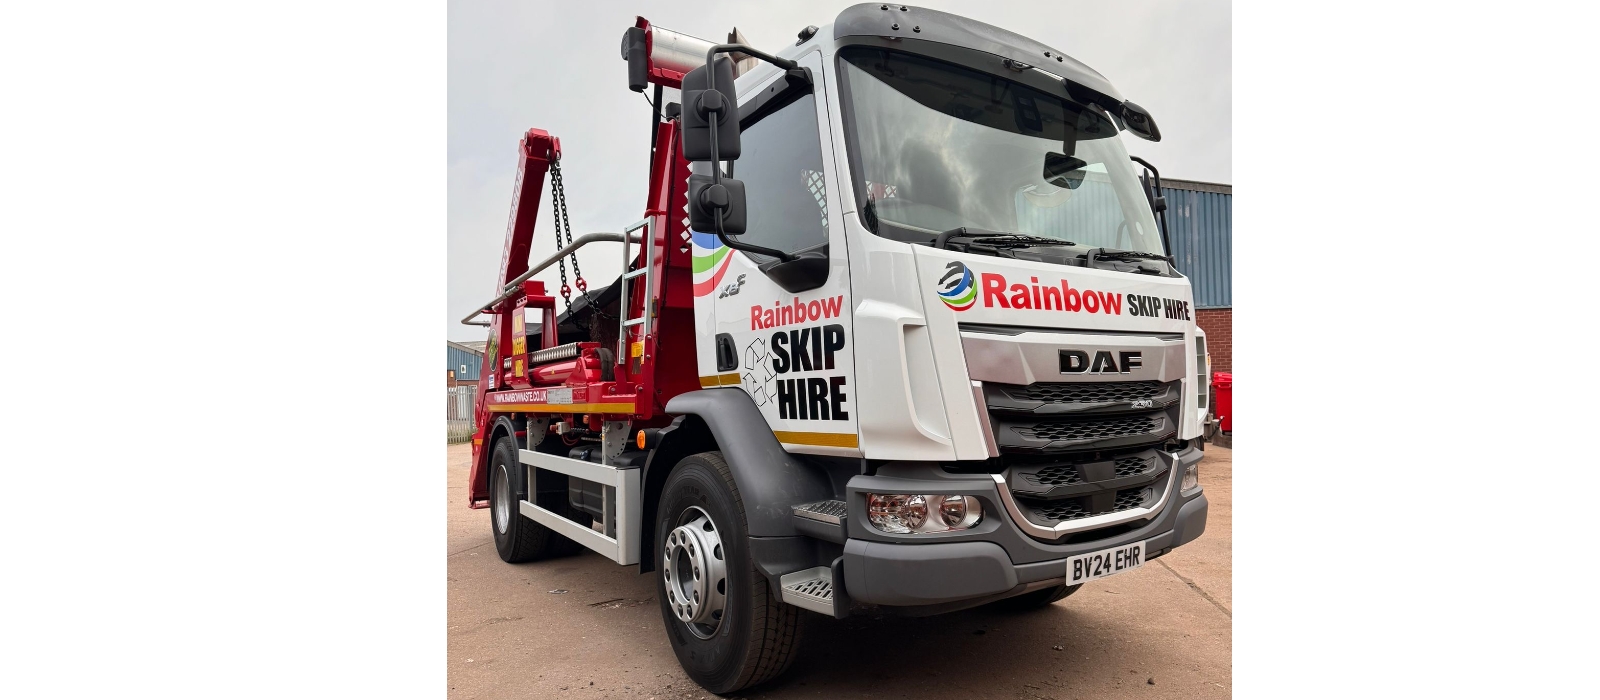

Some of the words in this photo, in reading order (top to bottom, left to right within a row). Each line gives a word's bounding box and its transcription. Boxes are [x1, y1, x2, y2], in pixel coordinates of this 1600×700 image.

[750, 295, 843, 331] Rainbow
[981, 272, 1122, 315] Rainbow
[1127, 293, 1162, 318] SKIP
[1163, 297, 1191, 321] HIRE
[771, 323, 846, 374] SKIP
[1058, 348, 1143, 376] DAF
[777, 376, 849, 421] HIRE
[1073, 552, 1112, 581] BV24
[1115, 545, 1141, 571] EHR
